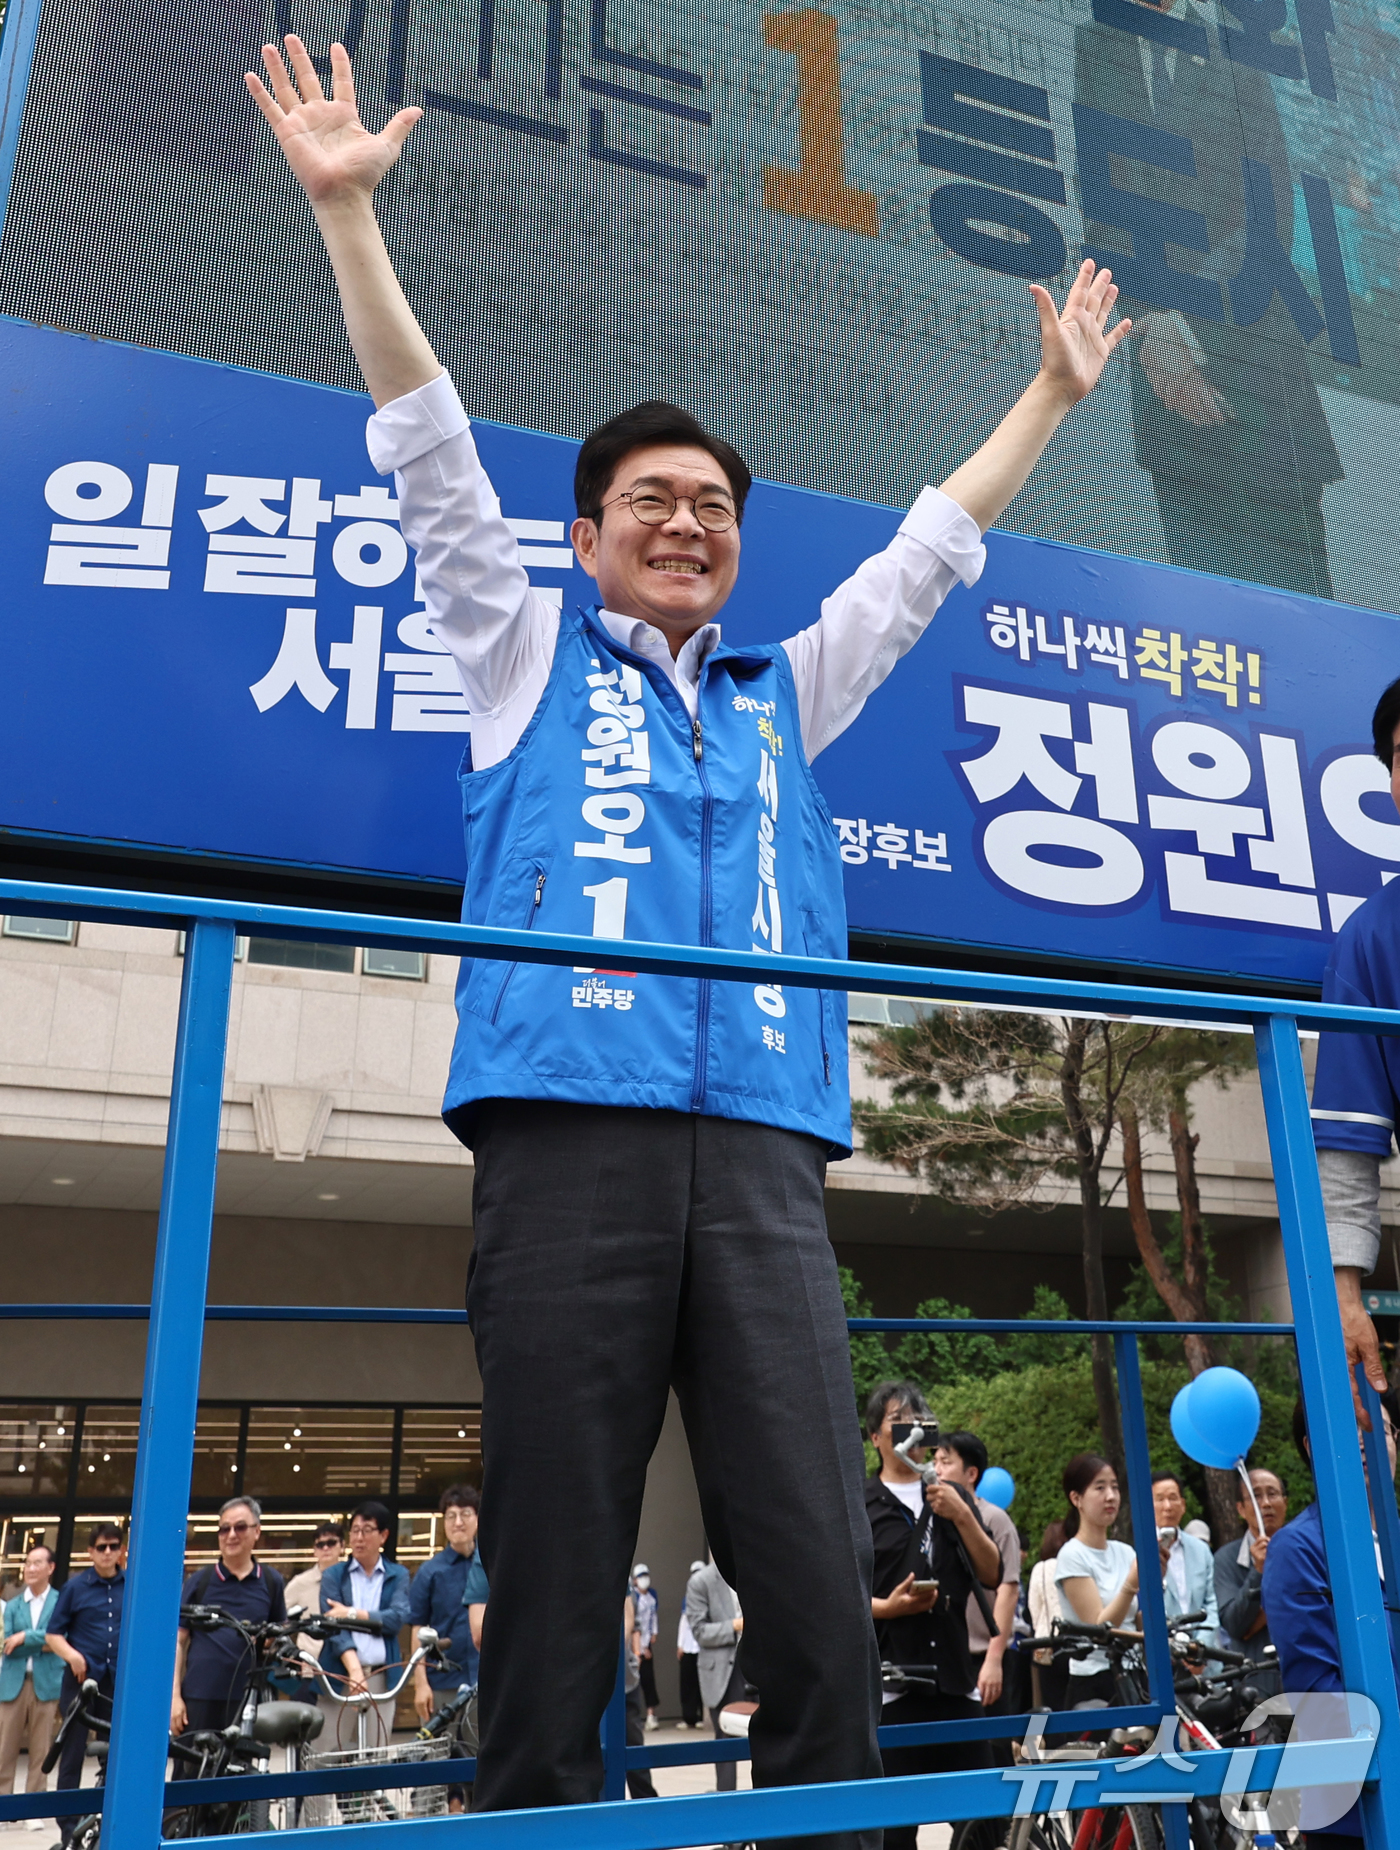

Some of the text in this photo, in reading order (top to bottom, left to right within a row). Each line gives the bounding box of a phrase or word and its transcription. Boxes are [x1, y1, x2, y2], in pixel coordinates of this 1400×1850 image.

[43, 461, 180, 590] 일
[986, 604, 1262, 708] 하나씩 착착!
[574, 658, 652, 864] 정원오
[832, 817, 952, 872] 장후보
[571, 986, 635, 1011] 민주당
[581, 977, 606, 990] 더불어
[761, 1024, 787, 1054] 후보
